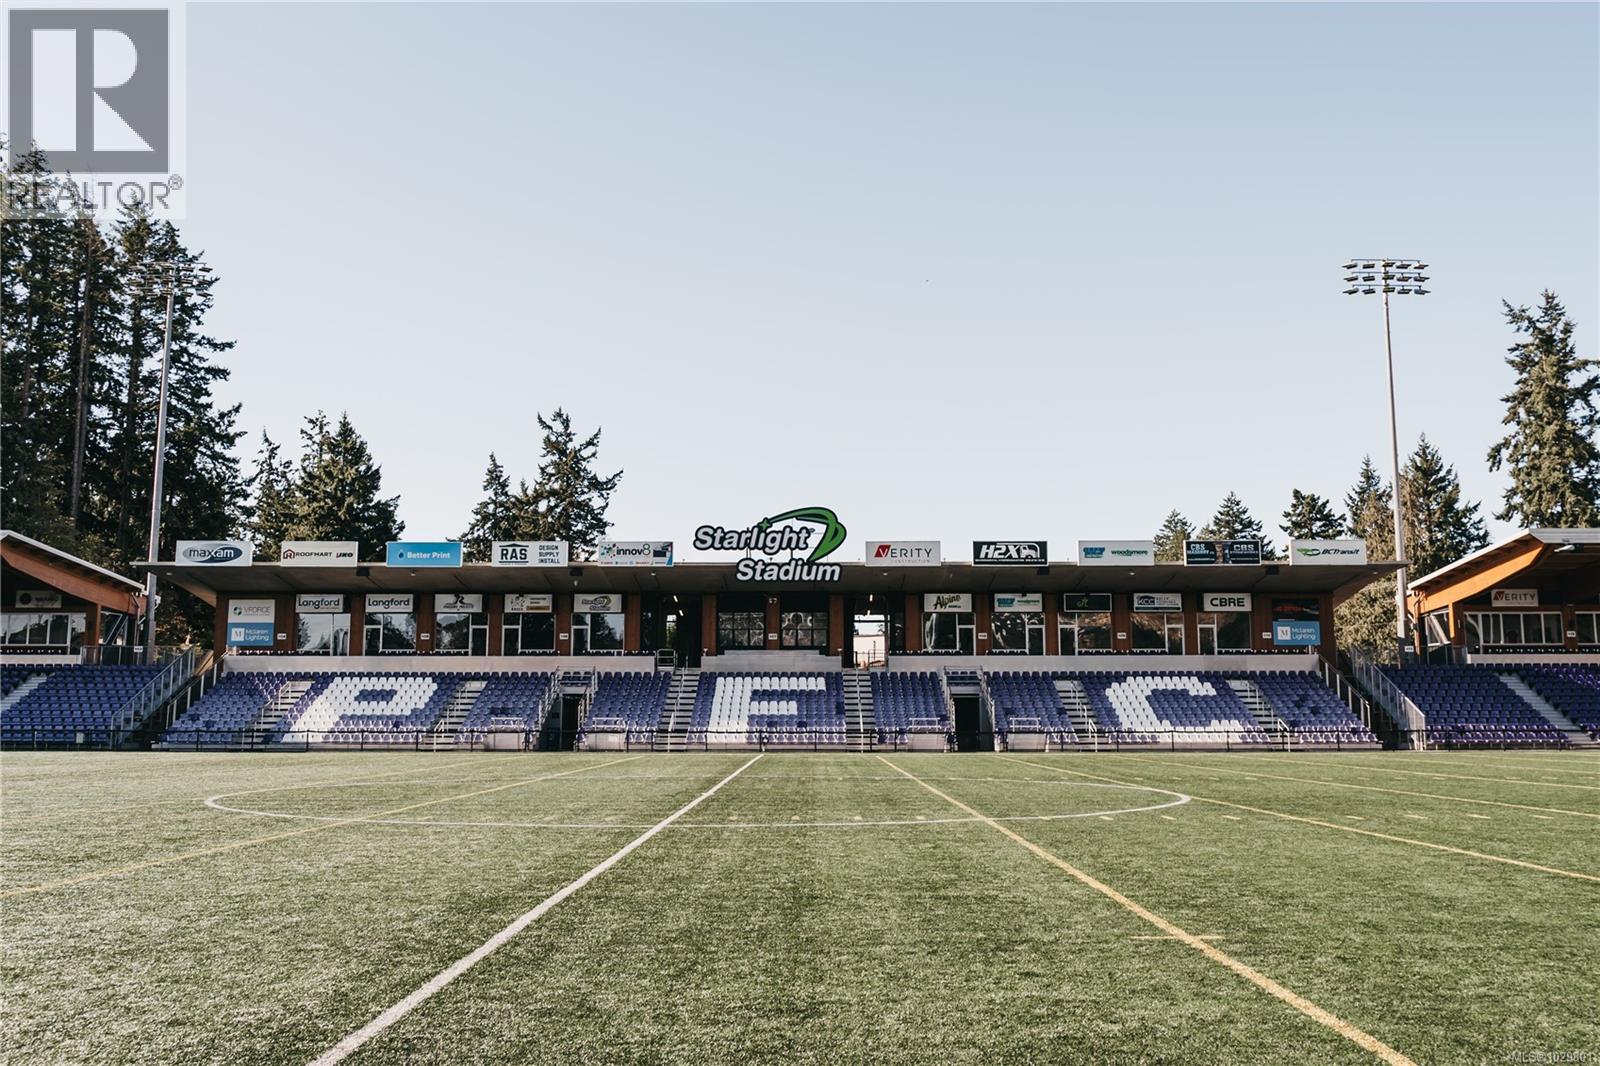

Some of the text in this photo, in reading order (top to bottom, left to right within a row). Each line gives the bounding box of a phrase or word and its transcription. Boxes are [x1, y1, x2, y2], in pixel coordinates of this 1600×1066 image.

[693, 525, 811, 555] Starlight
[616, 543, 651, 555] innov8
[879, 547, 933, 558] VERITY
[979, 544, 1021, 559] H2X
[1190, 543, 1206, 551] CBS
[188, 549, 235, 558] maxam
[407, 551, 450, 559] Better Print
[500, 548, 528, 560] RAS
[736, 556, 842, 582] Stadium
[932, 594, 962, 610] Alpine
[1210, 597, 1246, 607] CBRE
[1496, 592, 1536, 601] VERITY
[298, 597, 340, 609] Langford
[367, 597, 410, 609] Langford
